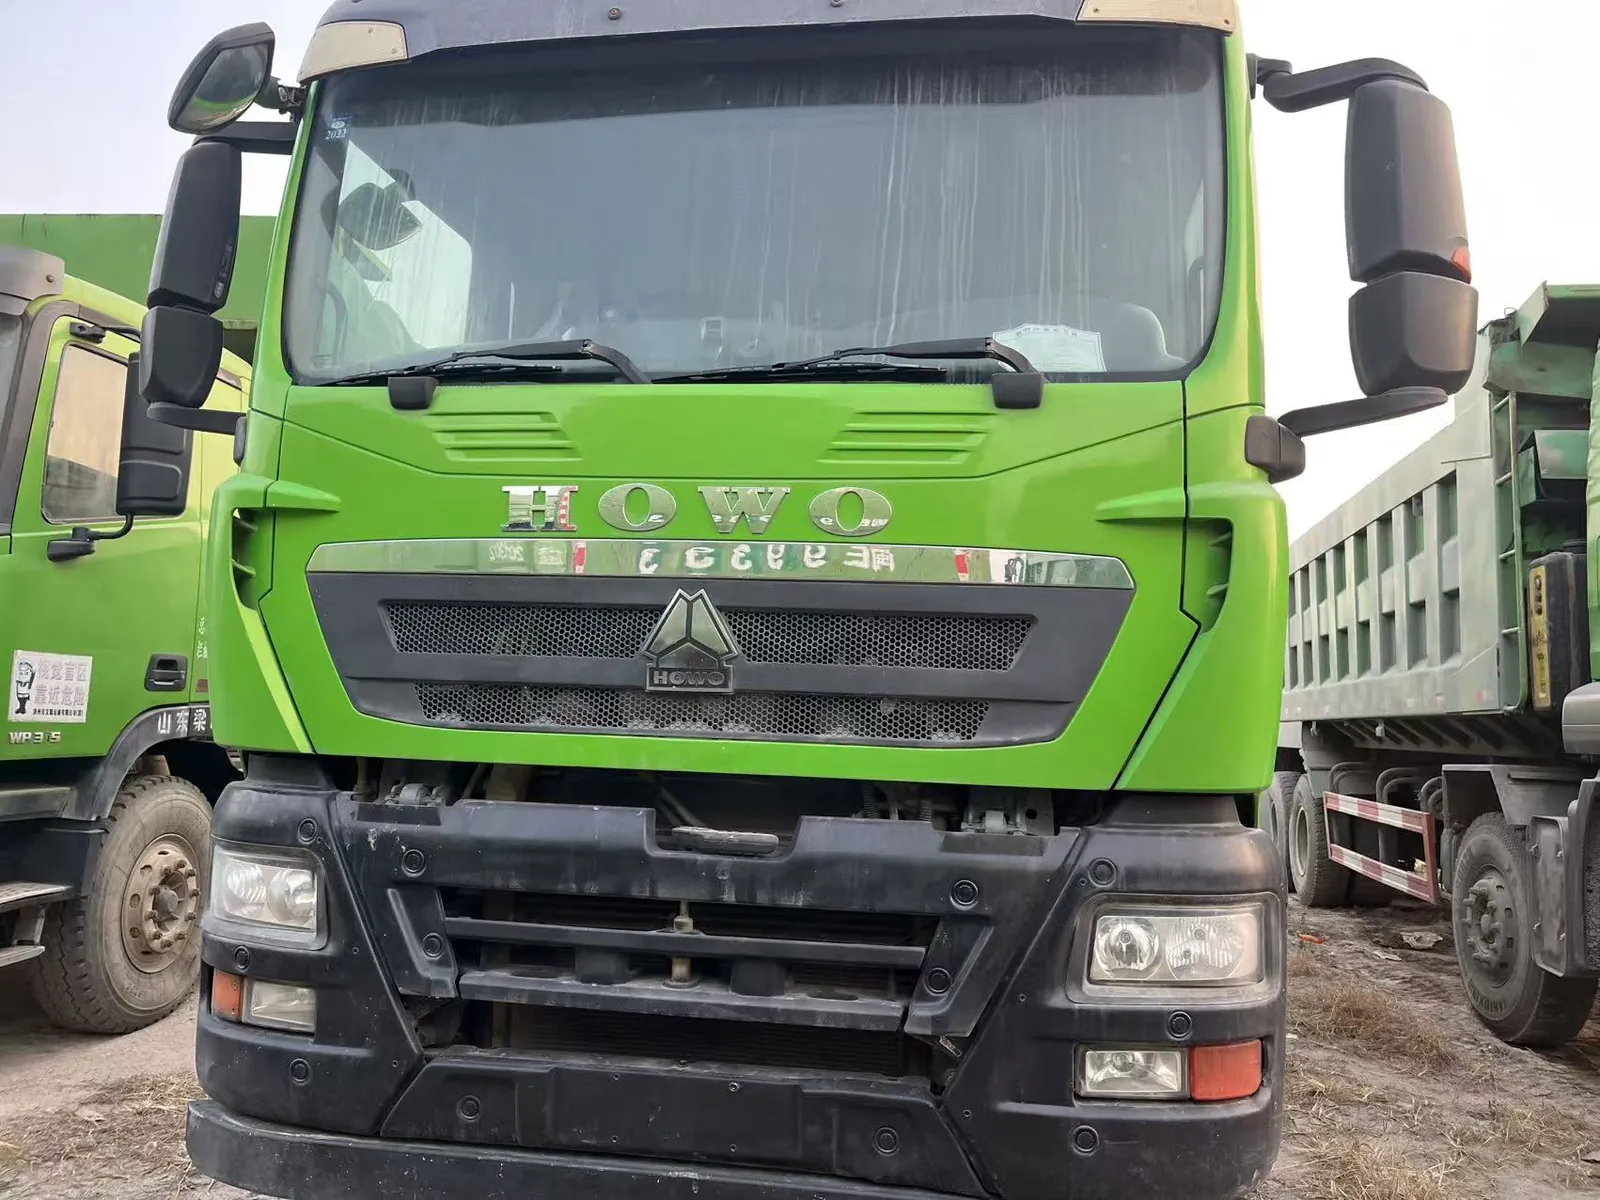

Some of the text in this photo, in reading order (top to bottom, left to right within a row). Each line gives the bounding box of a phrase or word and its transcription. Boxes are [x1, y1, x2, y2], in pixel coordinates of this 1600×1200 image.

[324, 128, 347, 140] 2022
[501, 482, 892, 536] HOWO
[653, 670, 725, 686] HOWO
[158, 708, 212, 734] 山东梁
[8, 731, 61, 744] WP35
